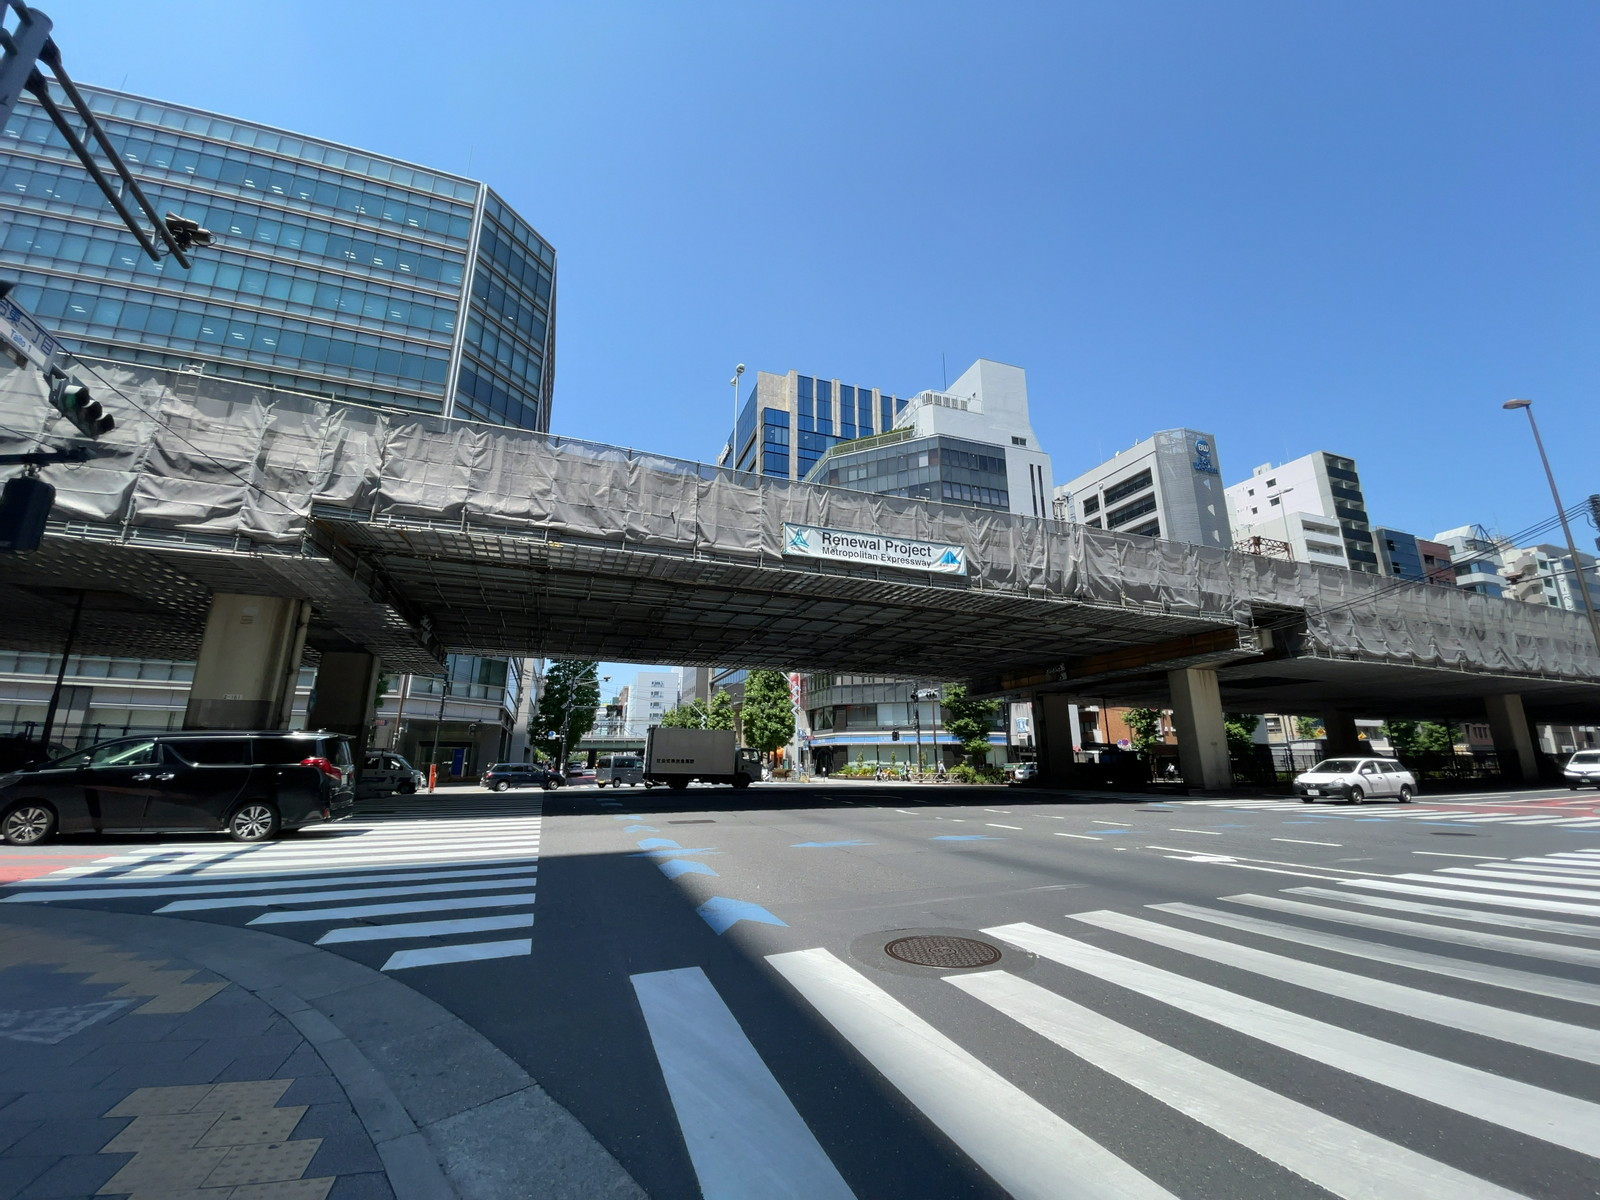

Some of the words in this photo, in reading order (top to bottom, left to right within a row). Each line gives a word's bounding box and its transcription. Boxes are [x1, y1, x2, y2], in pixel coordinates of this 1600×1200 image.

[10, 329, 26, 347] Taito
[822, 532, 880, 550] Renewal
[885, 540, 931, 557] Project
[822, 547, 877, 560] Metropolitan
[881, 554, 932, 568] Expressway
